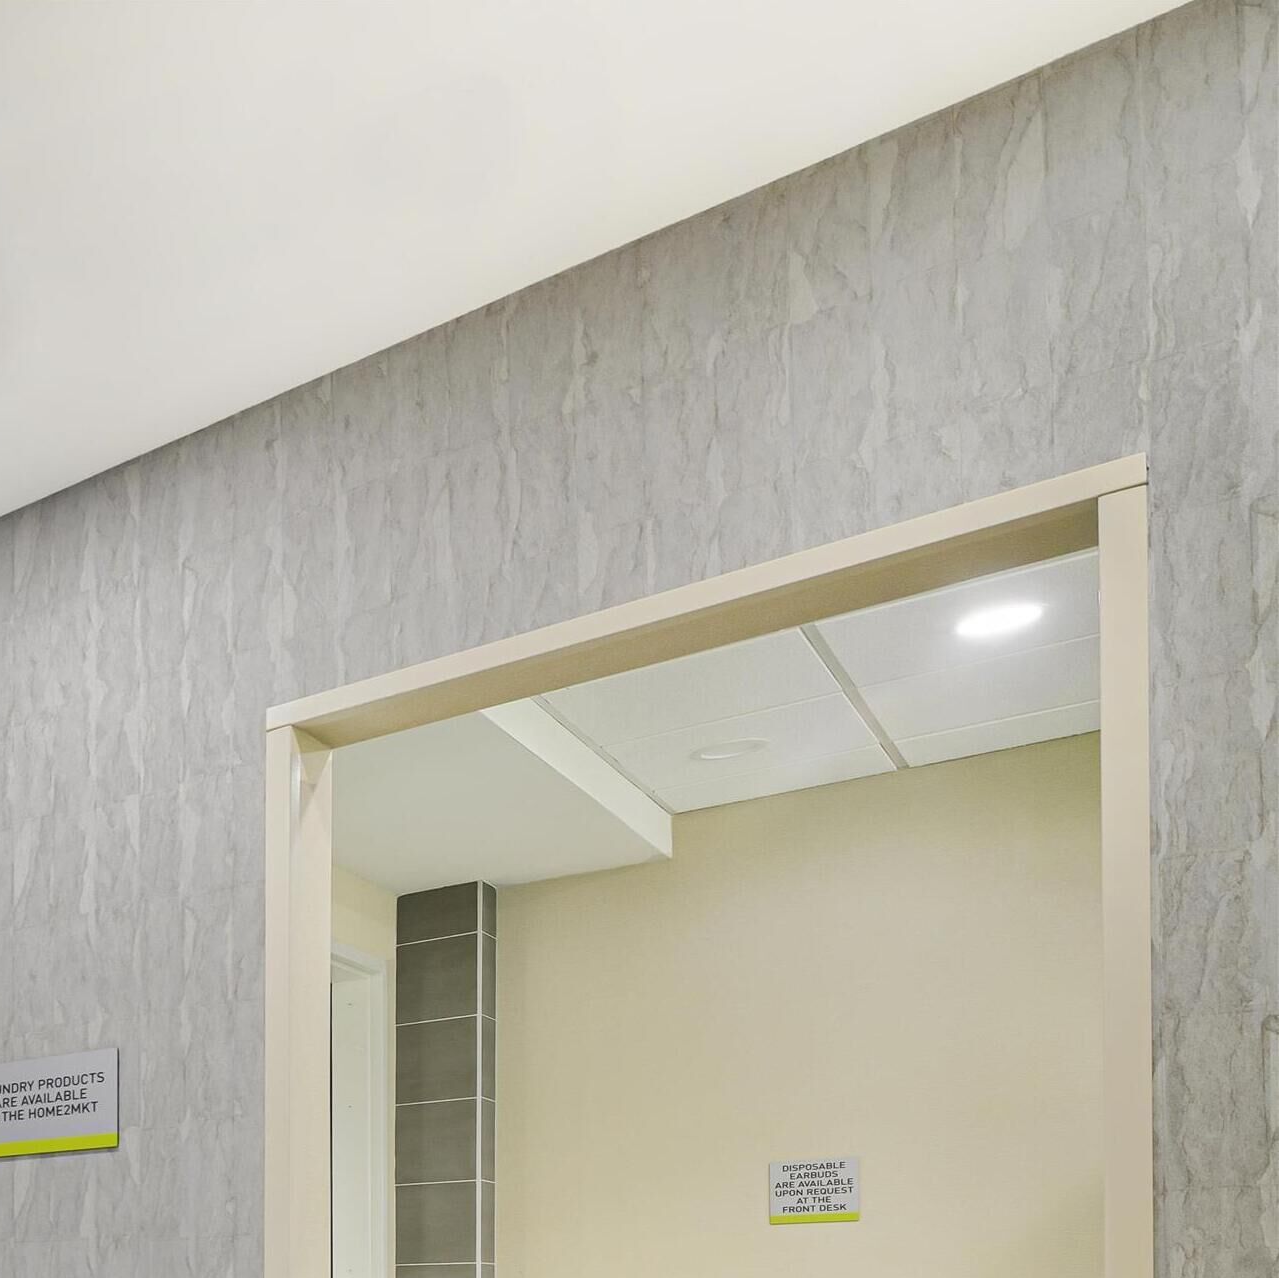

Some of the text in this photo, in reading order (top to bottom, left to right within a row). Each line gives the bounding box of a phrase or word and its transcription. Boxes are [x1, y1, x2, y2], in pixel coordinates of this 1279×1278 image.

[38, 1072, 105, 1091] PRODUCTS
[21, 1088, 88, 1106] AVAILABLE
[2, 1109, 24, 1122] THE
[28, 1101, 99, 1119] HOME2MKT
[782, 1161, 846, 1172] DISPOSABLE
[789, 1170, 839, 1180] EARBUDS
[775, 1177, 854, 1189] ARE AVAILABLE
[775, 1186, 854, 1197] UPON REQUEST
[812, 1195, 832, 1203] THE
[782, 1203, 847, 1213] FRONT DESK
